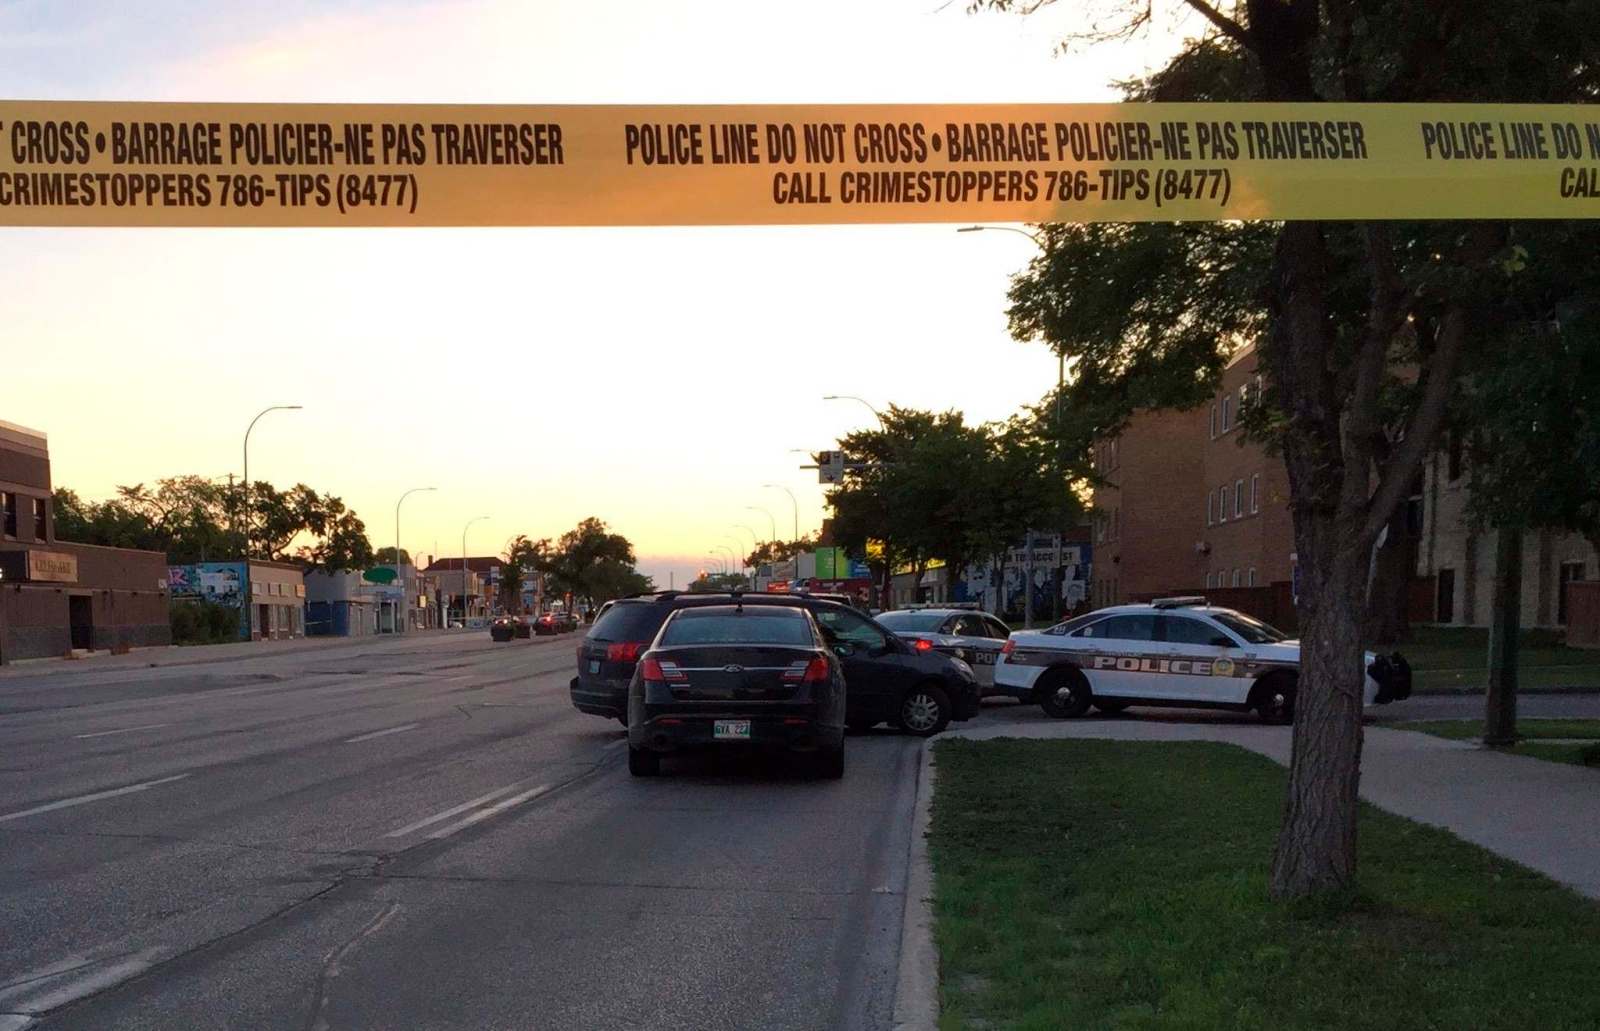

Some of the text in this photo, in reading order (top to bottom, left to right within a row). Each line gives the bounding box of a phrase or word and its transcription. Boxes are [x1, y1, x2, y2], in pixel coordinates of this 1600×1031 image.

[11, 121, 563, 165] CROSS BARRAGE POLICIER-NE PAS TRAVERSER
[625, 121, 1368, 165] POLICE LINE DO NOT CROSS BARRAGE POLICIER-NE PAS TRAVERSER
[1421, 122, 1497, 160] POLICE
[1500, 122, 1548, 159] LINE
[1551, 123, 1582, 160] DO
[0, 172, 417, 213] CRIMESTOPPERS 786-TIPS (8477)
[774, 168, 1231, 207] CALL CRIMESTOPPERS 786-TIPS (8477)
[1561, 168, 1600, 198] CAL
[1094, 656, 1212, 675] POLICE
